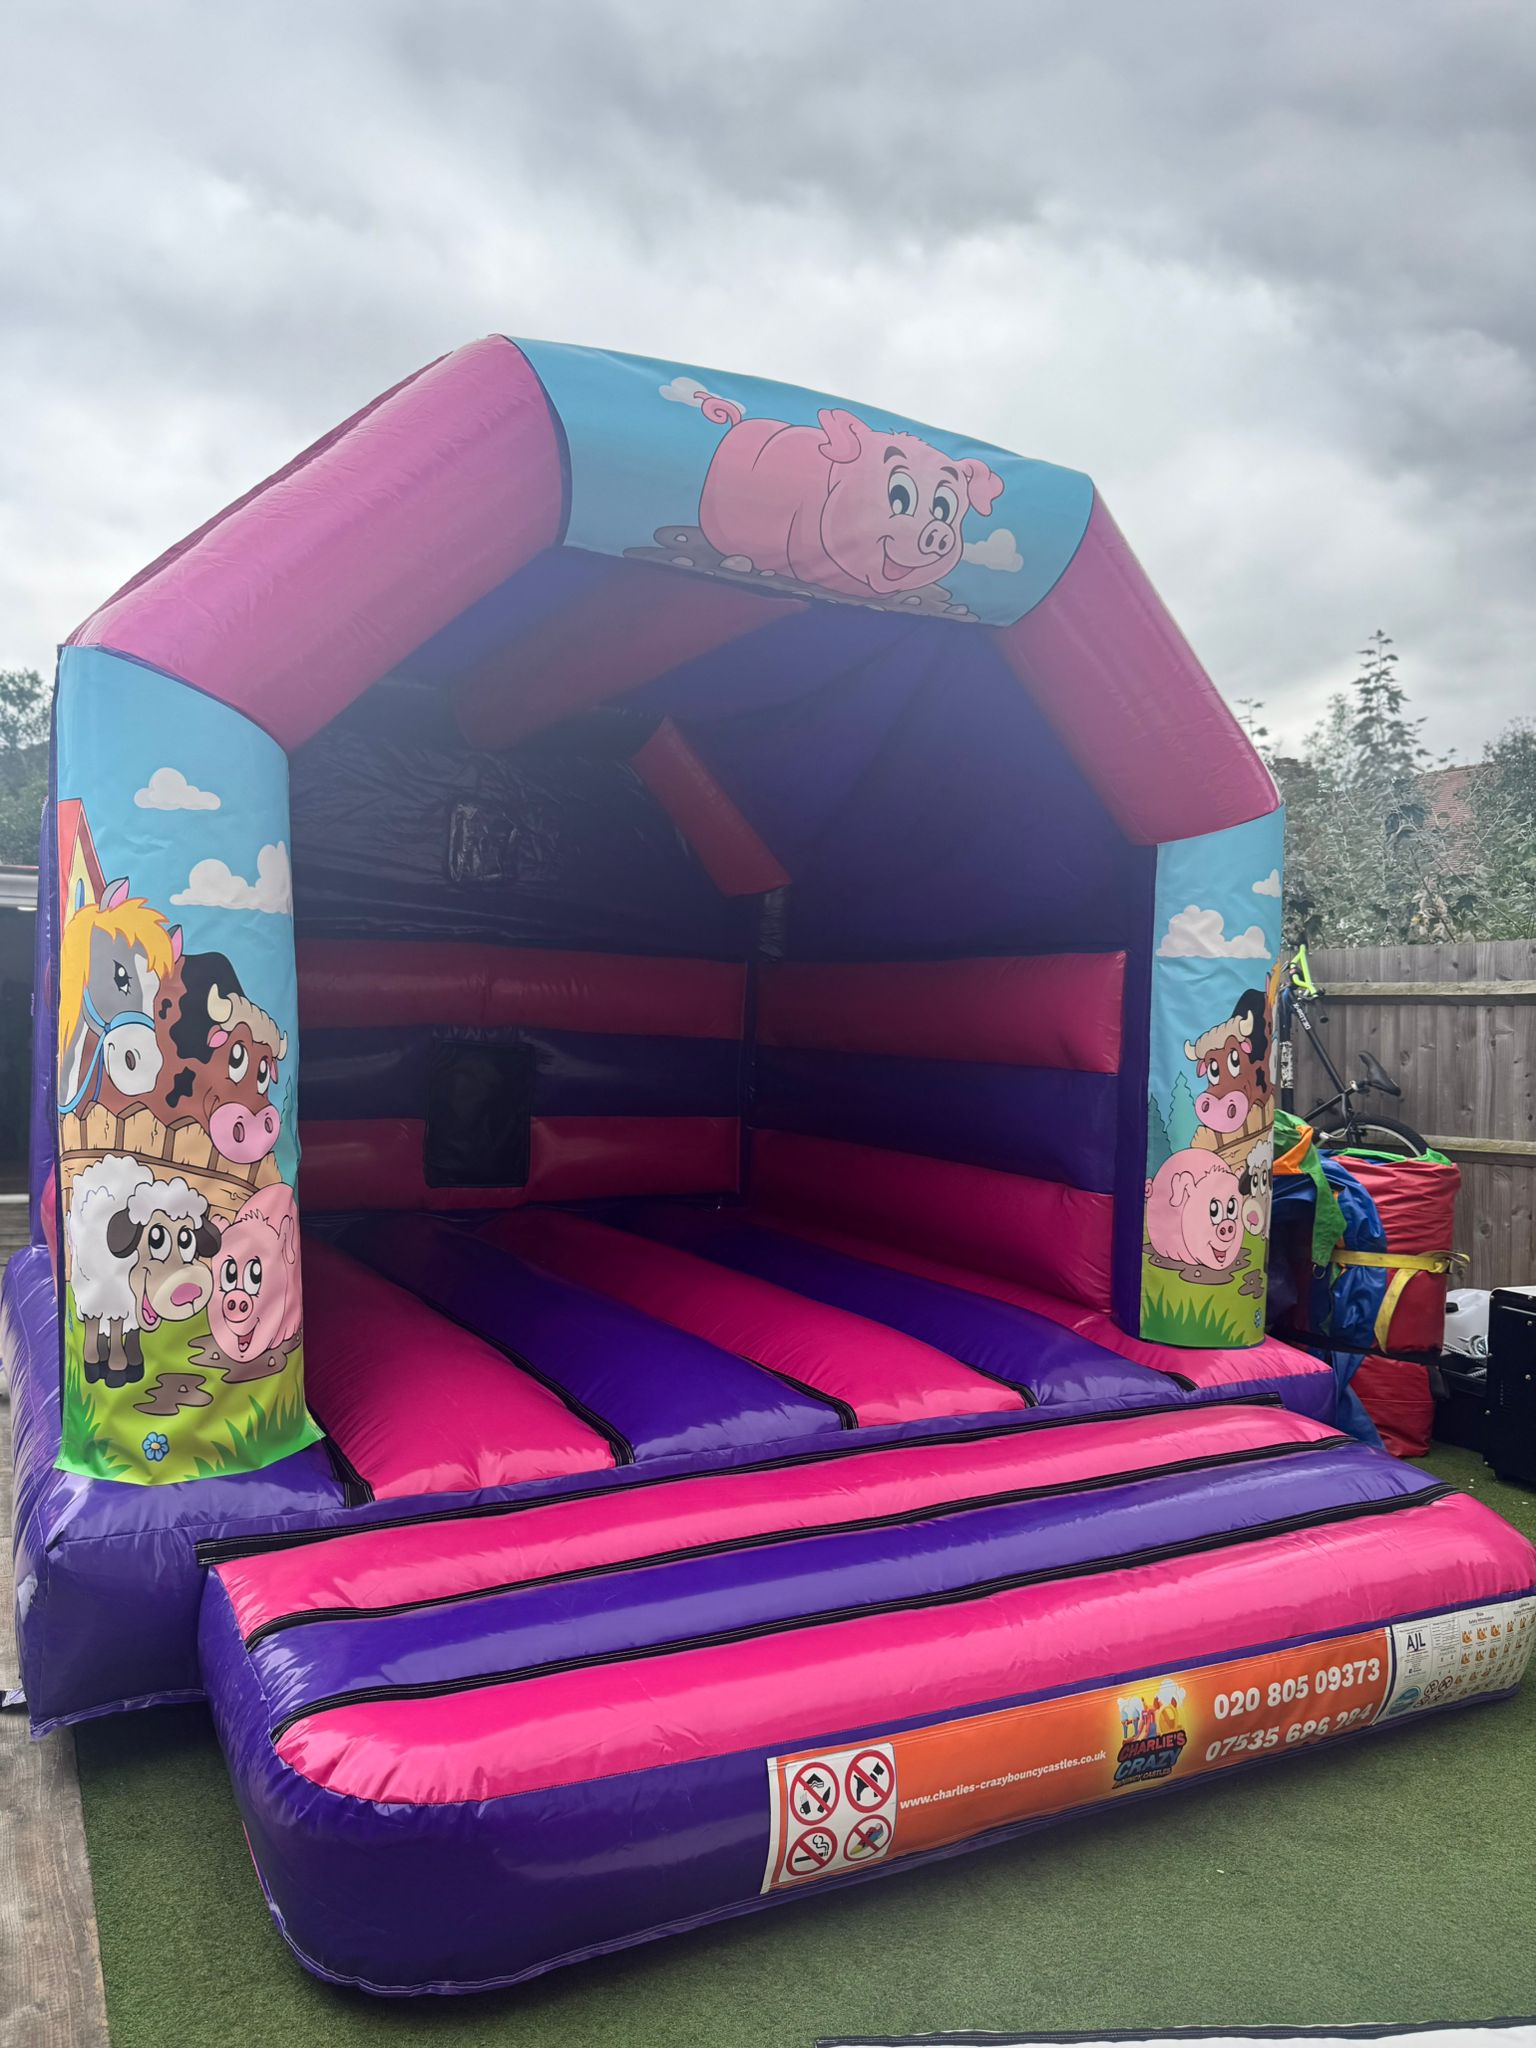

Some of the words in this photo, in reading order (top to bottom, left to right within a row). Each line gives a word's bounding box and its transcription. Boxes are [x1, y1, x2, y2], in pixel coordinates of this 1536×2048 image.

[1406, 1632, 1426, 1652] AJL
[1213, 1687, 1261, 1720] 020
[1267, 1675, 1310, 1708] 805
[1315, 1657, 1380, 1695] 09373
[1118, 1731, 1186, 1763] CHARLIE'S
[1205, 1726, 1280, 1762] 07535
[900, 1750, 1107, 1809] www.charlies-crazybouncycastles.co.uk
[1115, 1747, 1181, 1780] CRAZY
